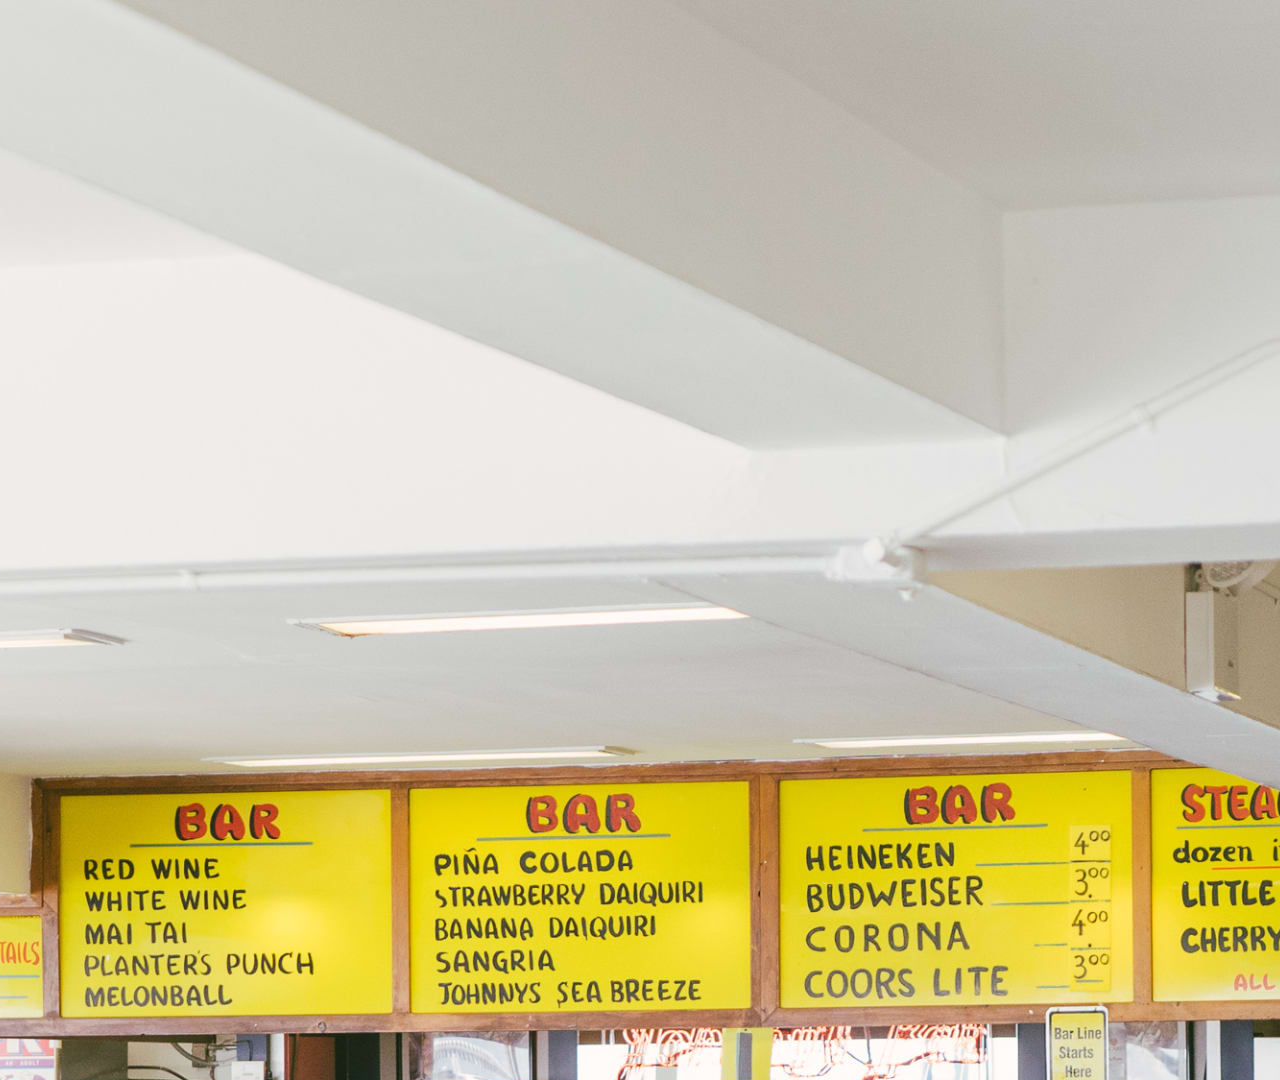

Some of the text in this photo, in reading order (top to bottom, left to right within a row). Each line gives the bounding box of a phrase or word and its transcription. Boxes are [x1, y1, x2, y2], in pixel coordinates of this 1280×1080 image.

[526, 793, 641, 834] BAR
[904, 782, 1016, 825] BAR
[175, 803, 281, 841] BAR
[435, 847, 633, 876] PIÑA COLADA
[806, 842, 955, 871] HEINEKEN
[1173, 840, 1252, 864] dozen
[84, 858, 220, 880] RED WINE
[85, 889, 247, 911] WHITE WINE
[435, 881, 703, 907] STRAWBERRY DAIQUIRI
[807, 875, 983, 913] BUDWEISER
[1182, 879, 1275, 908] LITTLE
[85, 922, 187, 945] MAI TAI
[435, 915, 656, 941] BANANA DAIQUIRI
[806, 921, 969, 952] CORONA
[85, 950, 314, 976] PLANTER'S PUNCH
[436, 949, 555, 974] SANGRIA
[438, 979, 702, 1008] JOHNNYS SEA BREEZE
[804, 968, 915, 998] COORS
[934, 966, 1009, 996] LITE
[1233, 973, 1276, 992] ALL
[85, 984, 233, 1007] MELONBALL
[1054, 1027, 1102, 1040] Bar Line
[1059, 1046, 1094, 1060] Starts
[1065, 1066, 1092, 1078] Here
